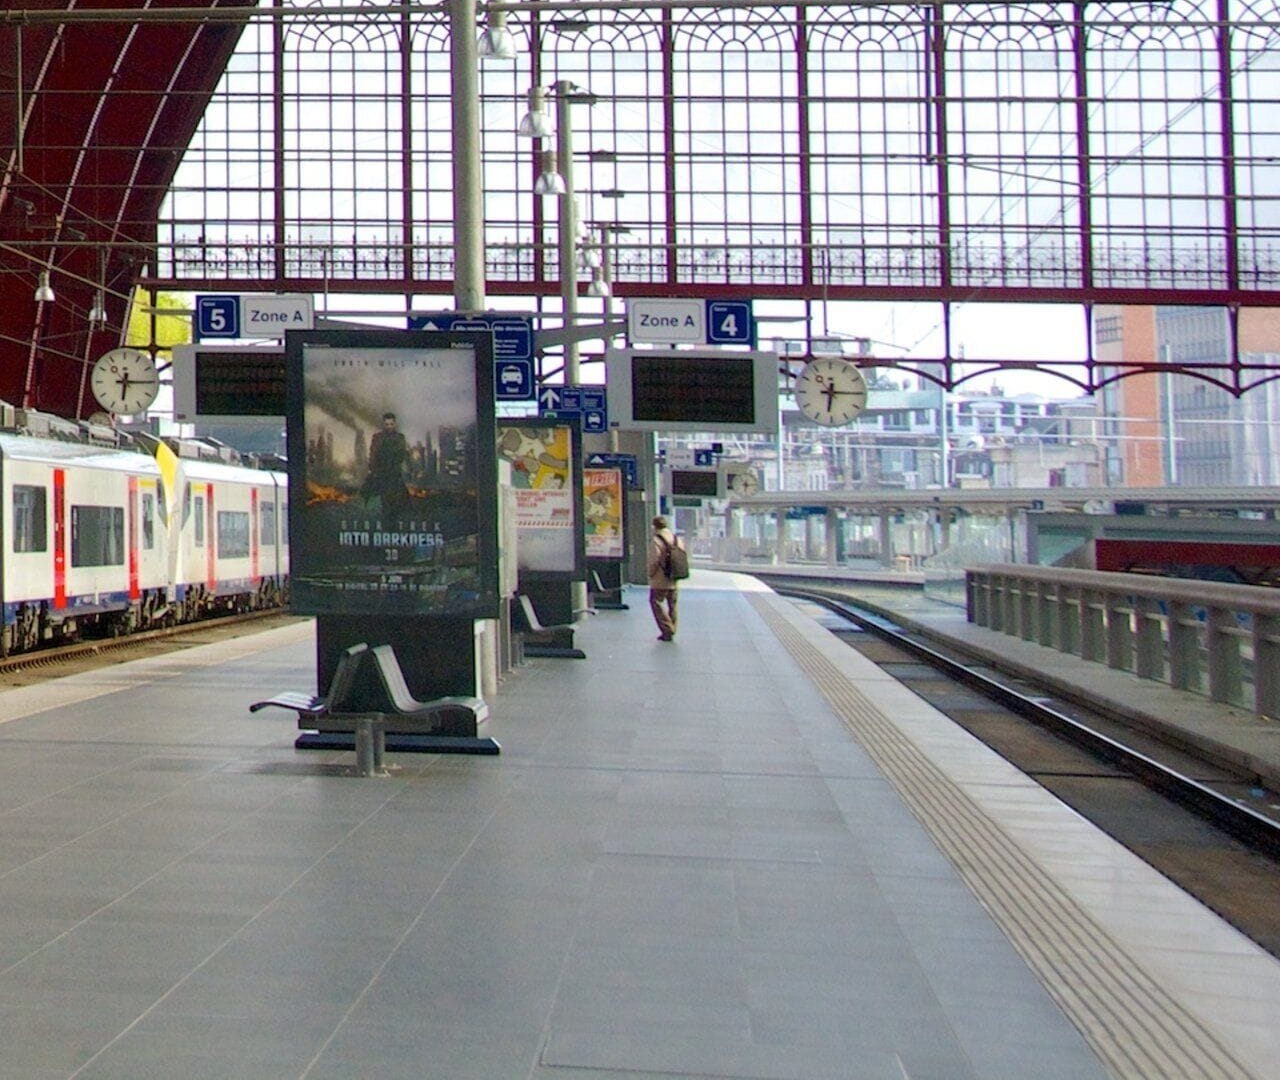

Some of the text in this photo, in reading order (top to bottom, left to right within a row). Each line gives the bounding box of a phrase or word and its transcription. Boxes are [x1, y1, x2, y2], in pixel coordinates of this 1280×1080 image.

[210, 308, 226, 331] 5
[251, 310, 304, 322] Zone A
[640, 314, 696, 327] Zone A
[721, 313, 738, 337] 4
[339, 531, 444, 547] INTO DARKNESS
